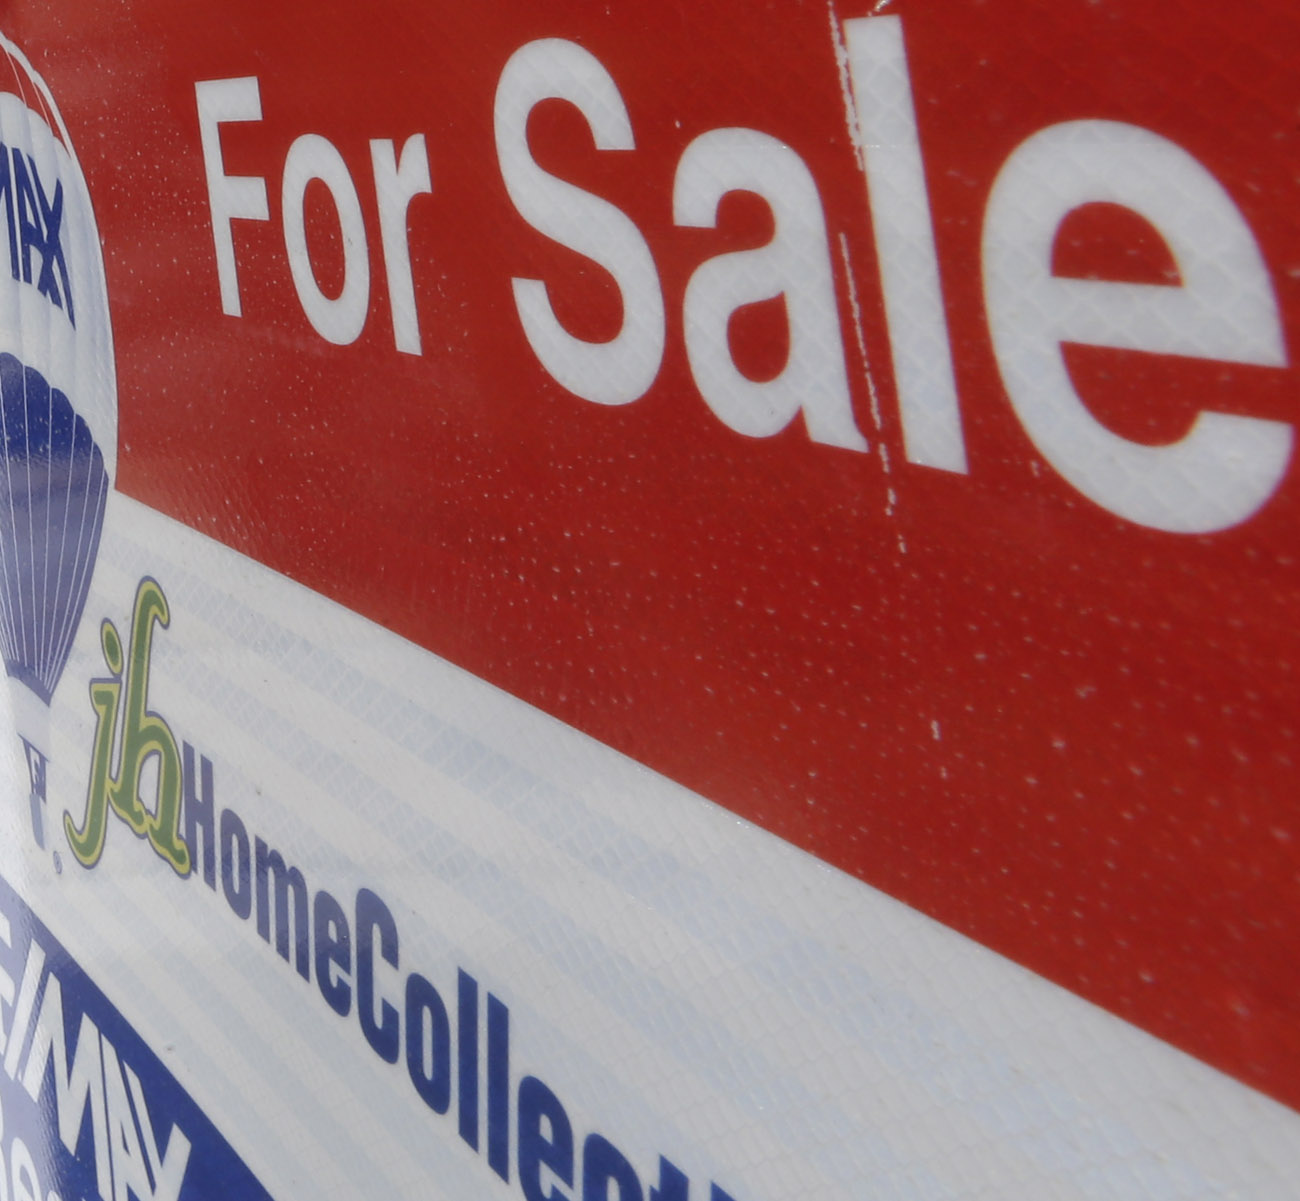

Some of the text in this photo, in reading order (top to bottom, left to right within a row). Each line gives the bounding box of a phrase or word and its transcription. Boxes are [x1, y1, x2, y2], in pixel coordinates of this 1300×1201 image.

[194, 14, 1293, 535] For Sale
[182, 739, 736, 1201] HomeColle
